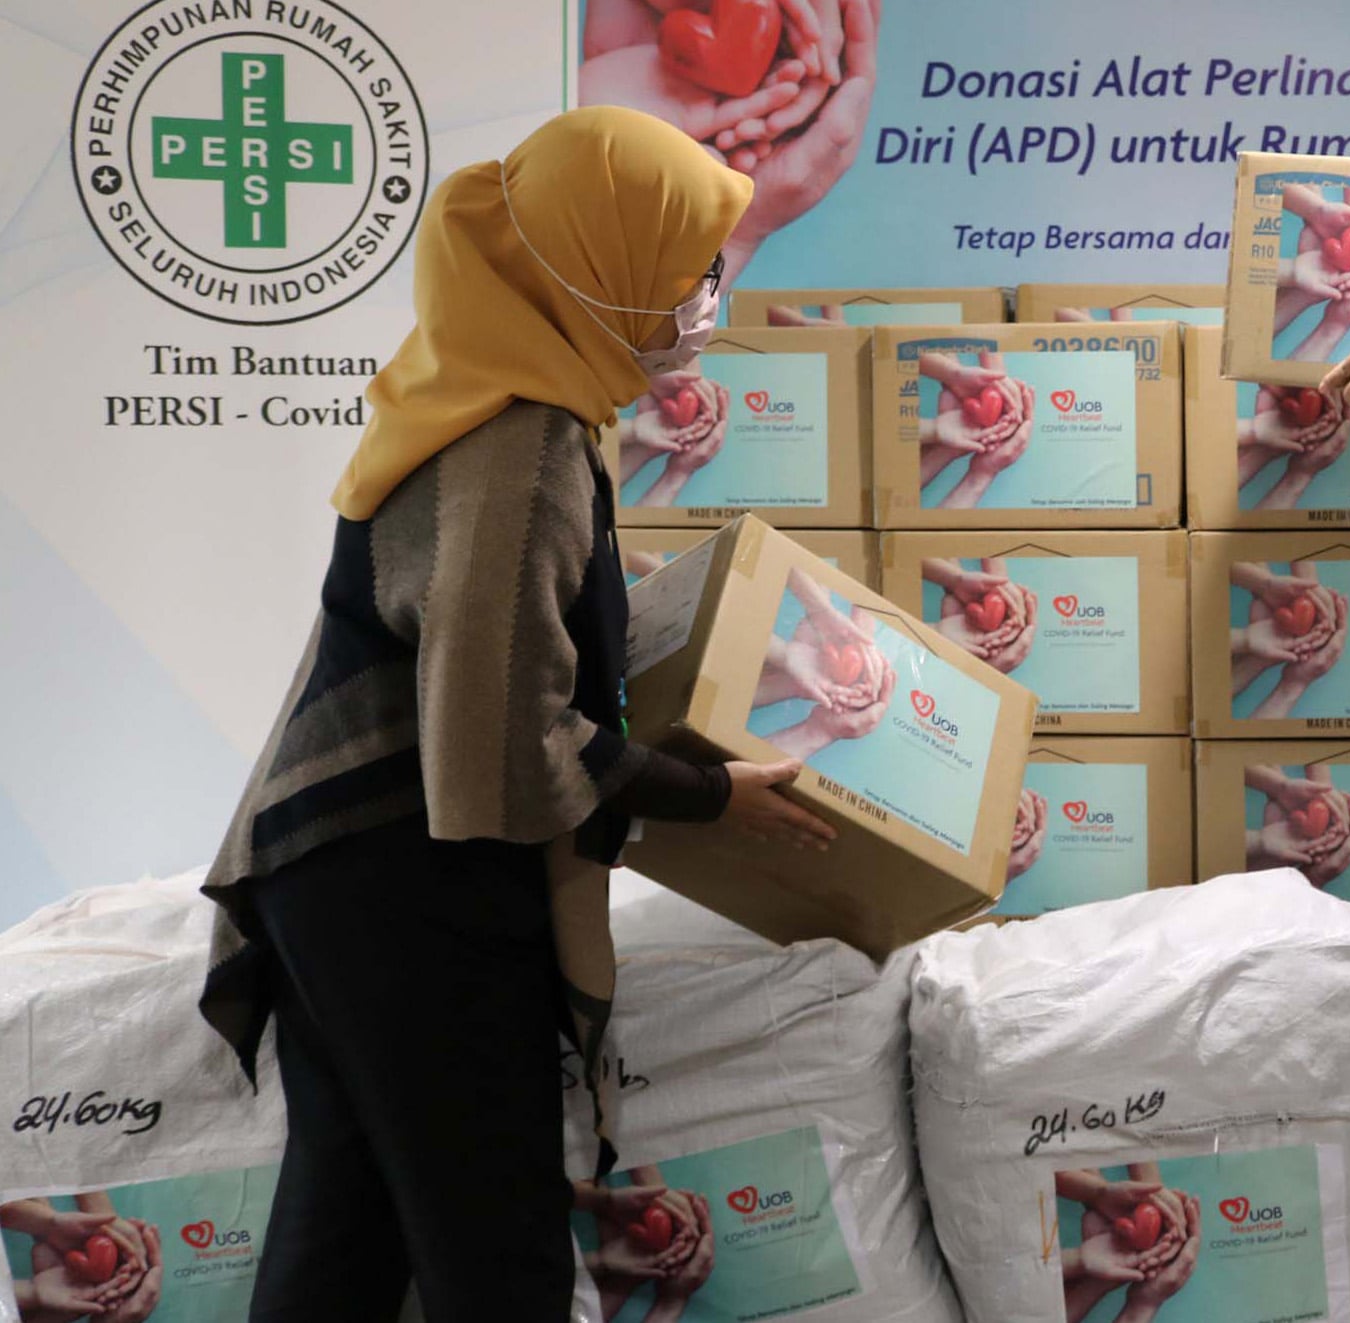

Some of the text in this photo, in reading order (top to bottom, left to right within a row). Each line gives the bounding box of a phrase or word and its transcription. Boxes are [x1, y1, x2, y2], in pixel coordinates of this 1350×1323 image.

[89, 0, 411, 169] PERHIMPUNAN RUMAH SAKIT
[922, 59, 1081, 98] Donasi
[1093, 55, 1192, 97] Alat
[161, 135, 342, 170] PERSI
[242, 60, 269, 241] PERSI
[875, 126, 955, 164] Diri
[968, 122, 1096, 175] (APD)
[1110, 121, 1246, 163] untuk
[953, 224, 1036, 257] Tetap
[1045, 224, 1174, 250] Bersama
[109, 202, 396, 305] SELURUH INDONESIA
[144, 346, 377, 376] Tim Bantuan
[104, 397, 222, 426] PERSI
[261, 396, 364, 427] Covid
[767, 402, 794, 413] UOB
[1074, 401, 1103, 412] UOB
[688, 507, 711, 518] MADE
[712, 507, 722, 518] IN
[1308, 510, 1333, 521] MADE
[1336, 510, 1346, 521] IN
[1077, 607, 1105, 618] UOB
[931, 713, 958, 737] UOB
[1306, 718, 1330, 728] MADE
[1334, 718, 1344, 728] IN
[817, 776, 888, 824] MADE IN CHINA
[1086, 813, 1114, 823] UOB
[759, 1190, 793, 1210] UOB
[1249, 1206, 1283, 1222] UOB
[215, 1230, 251, 1246] UOB
